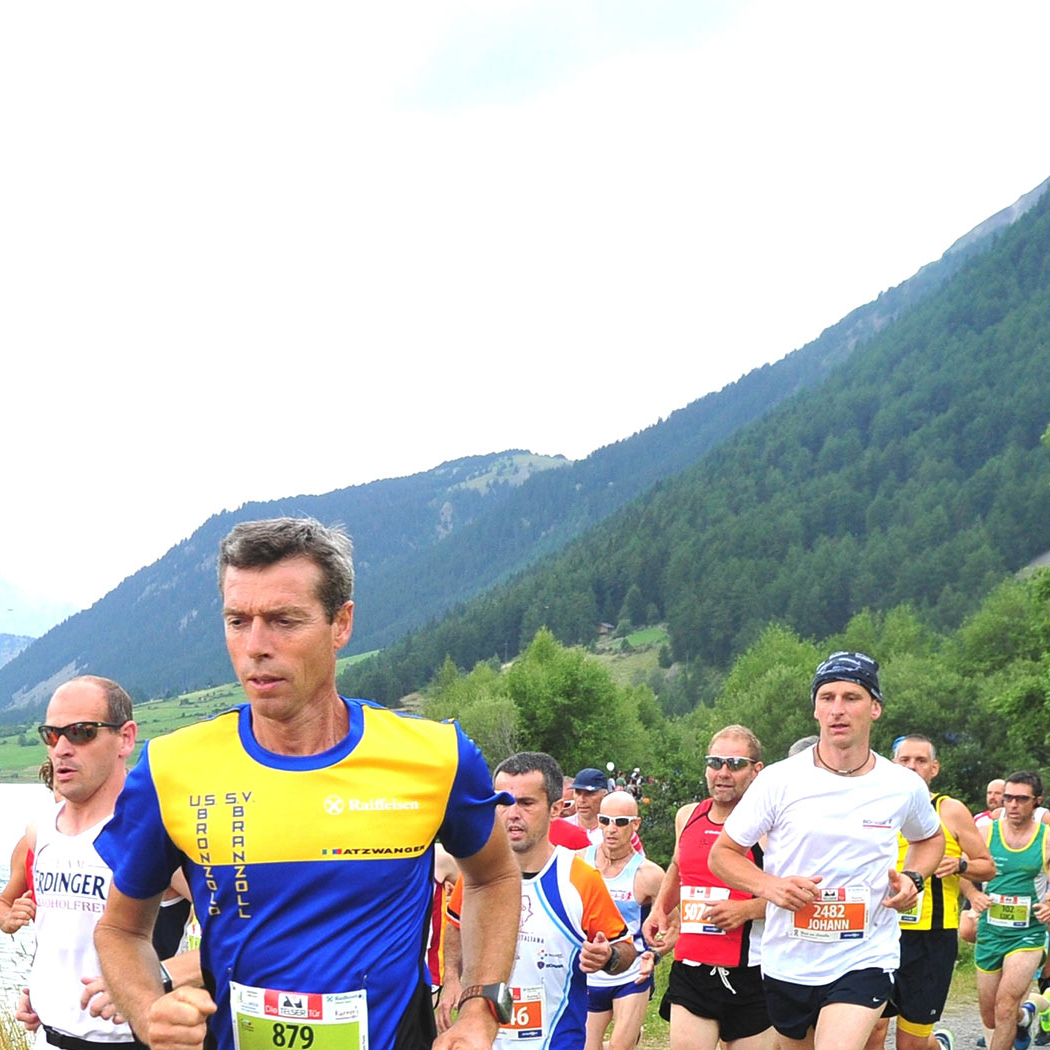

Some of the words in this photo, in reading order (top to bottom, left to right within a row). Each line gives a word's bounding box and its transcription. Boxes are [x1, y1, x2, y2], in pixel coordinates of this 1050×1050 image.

[349, 798, 419, 810] Raiffeisen
[196, 808, 221, 916] BRONZOLO
[232, 805, 252, 918] BRANZOLL
[813, 904, 846, 918] 2482
[807, 919, 850, 930] JOHANN
[272, 1022, 314, 1050] 879
